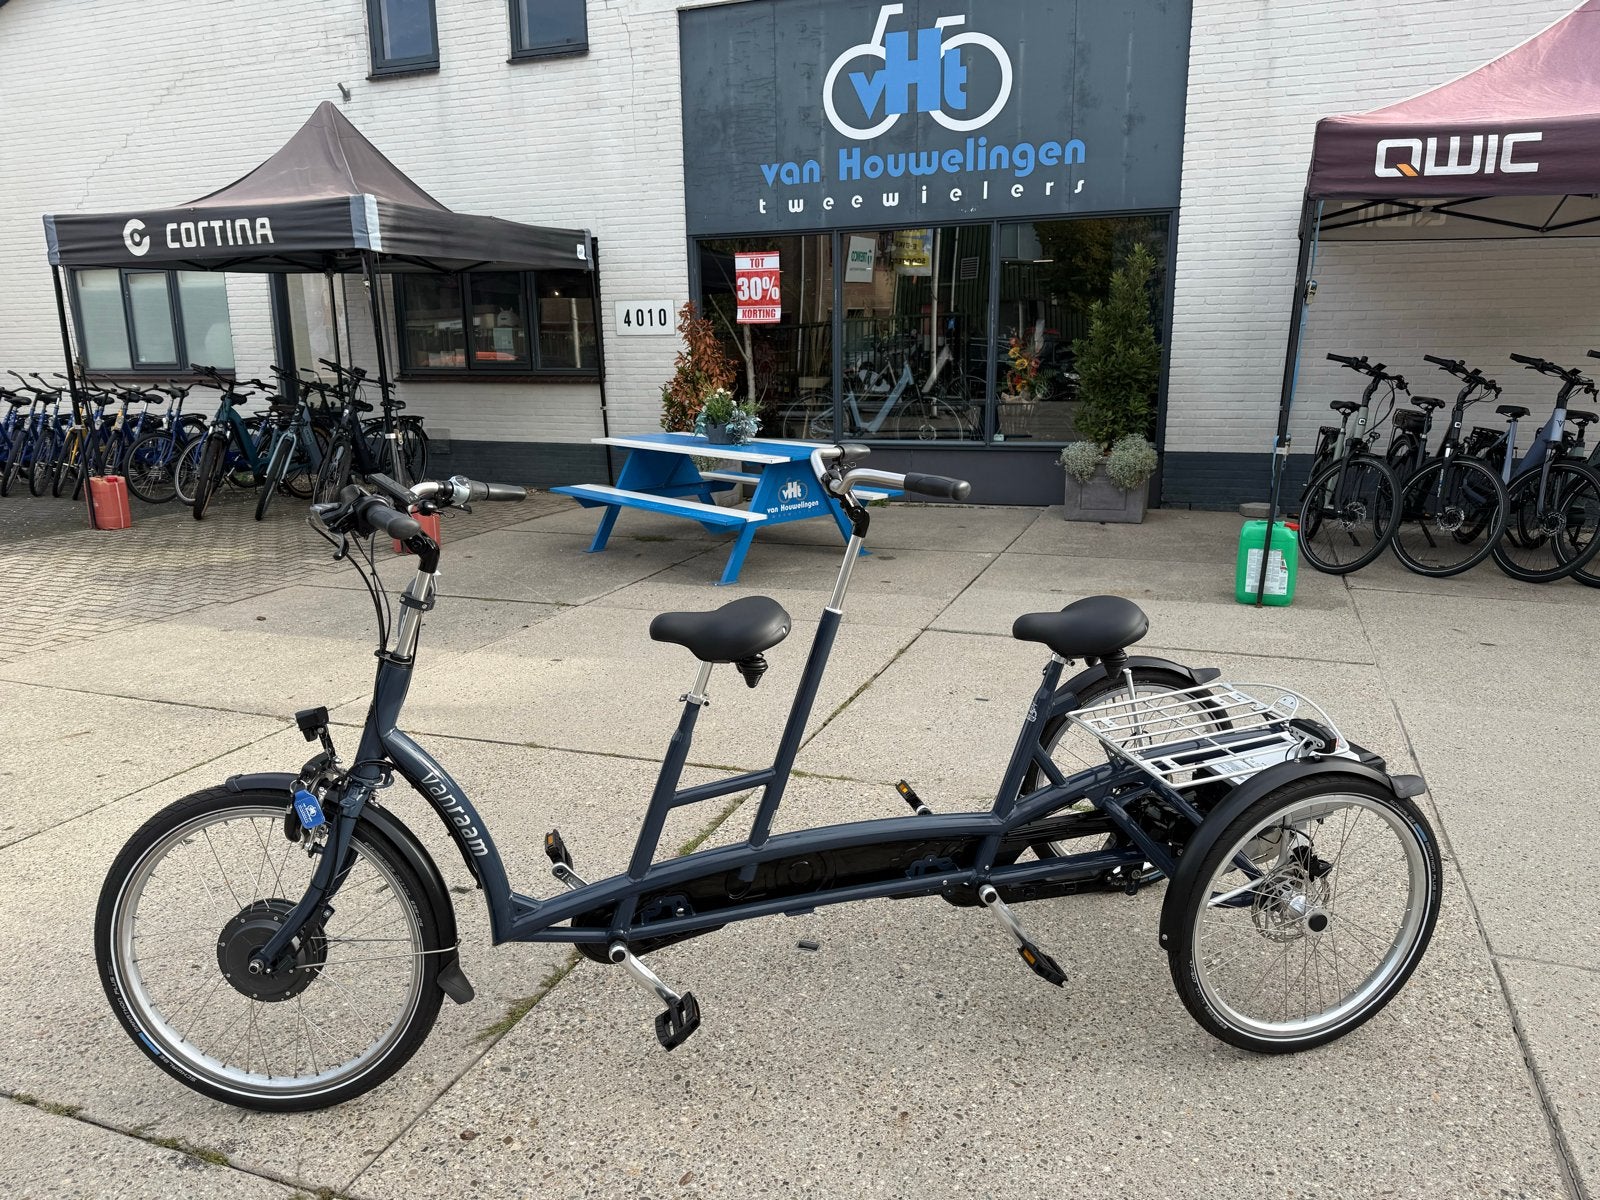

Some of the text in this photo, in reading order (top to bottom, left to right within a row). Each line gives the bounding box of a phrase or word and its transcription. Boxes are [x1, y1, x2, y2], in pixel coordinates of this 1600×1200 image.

[848, 27, 967, 120] vHt
[760, 136, 1086, 188] van Houwelingen
[1375, 131, 1543, 178] QWIC
[759, 179, 1085, 214] tweewielers
[166, 217, 275, 249] CORTINA
[749, 258, 765, 268] TOT
[737, 275, 780, 301] 30%
[623, 308, 667, 327] 4010
[742, 308, 776, 319] KORTING
[782, 481, 802, 500] vHt
[780, 500, 819, 512] Houwelingen
[420, 771, 489, 857] Vanraam
[108, 976, 120, 996] PLUS
